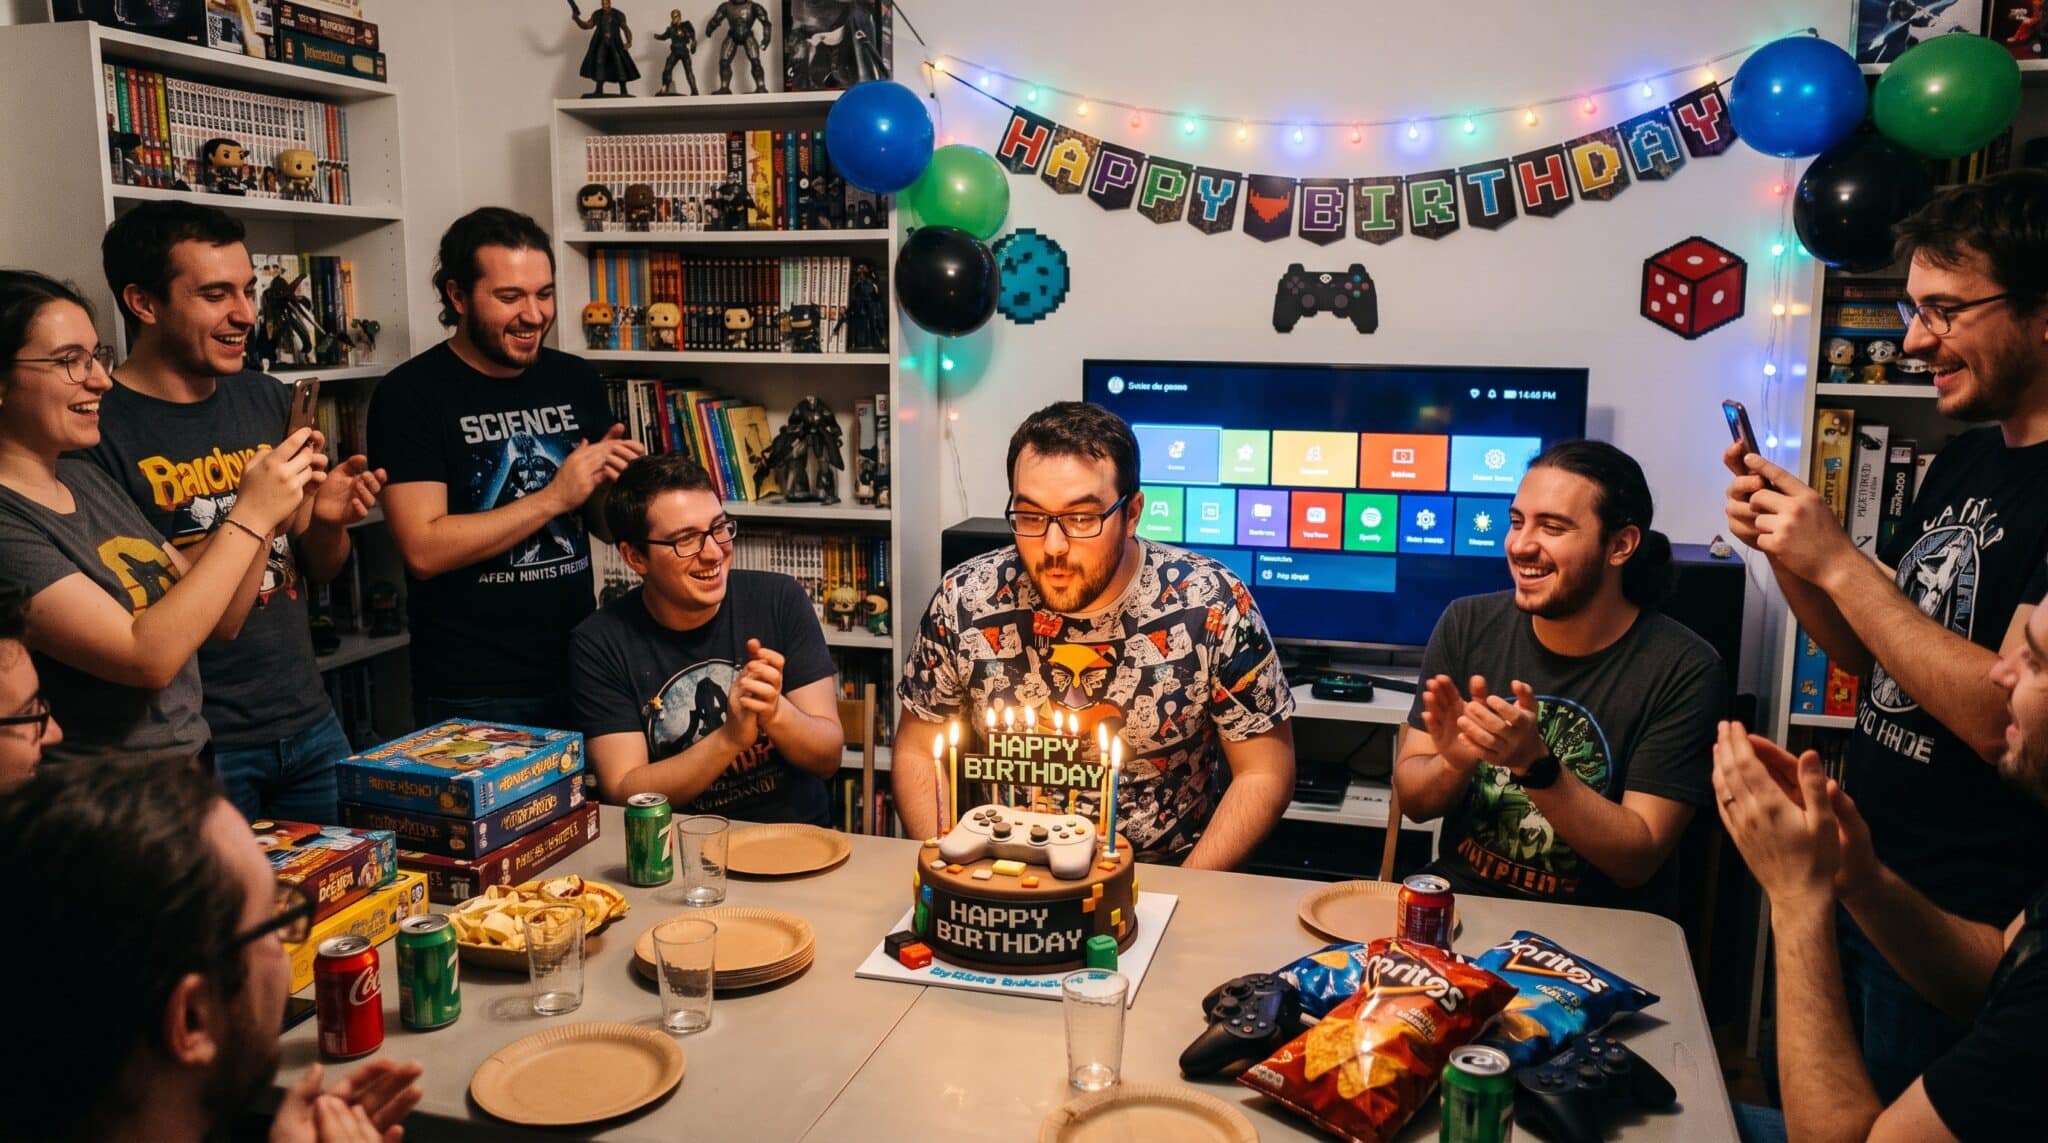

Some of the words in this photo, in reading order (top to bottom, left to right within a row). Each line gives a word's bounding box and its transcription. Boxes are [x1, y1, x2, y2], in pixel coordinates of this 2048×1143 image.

[1001, 115, 1236, 222] HAPPY
[1302, 93, 1723, 232] BIRTHDAY
[459, 404, 580, 445] SCIENCE
[988, 733, 1080, 762] HAPPY
[963, 757, 1105, 789] BIRTHDAY
[949, 900, 1049, 929] HAPPY
[936, 918, 1083, 955] BIRTHDAY
